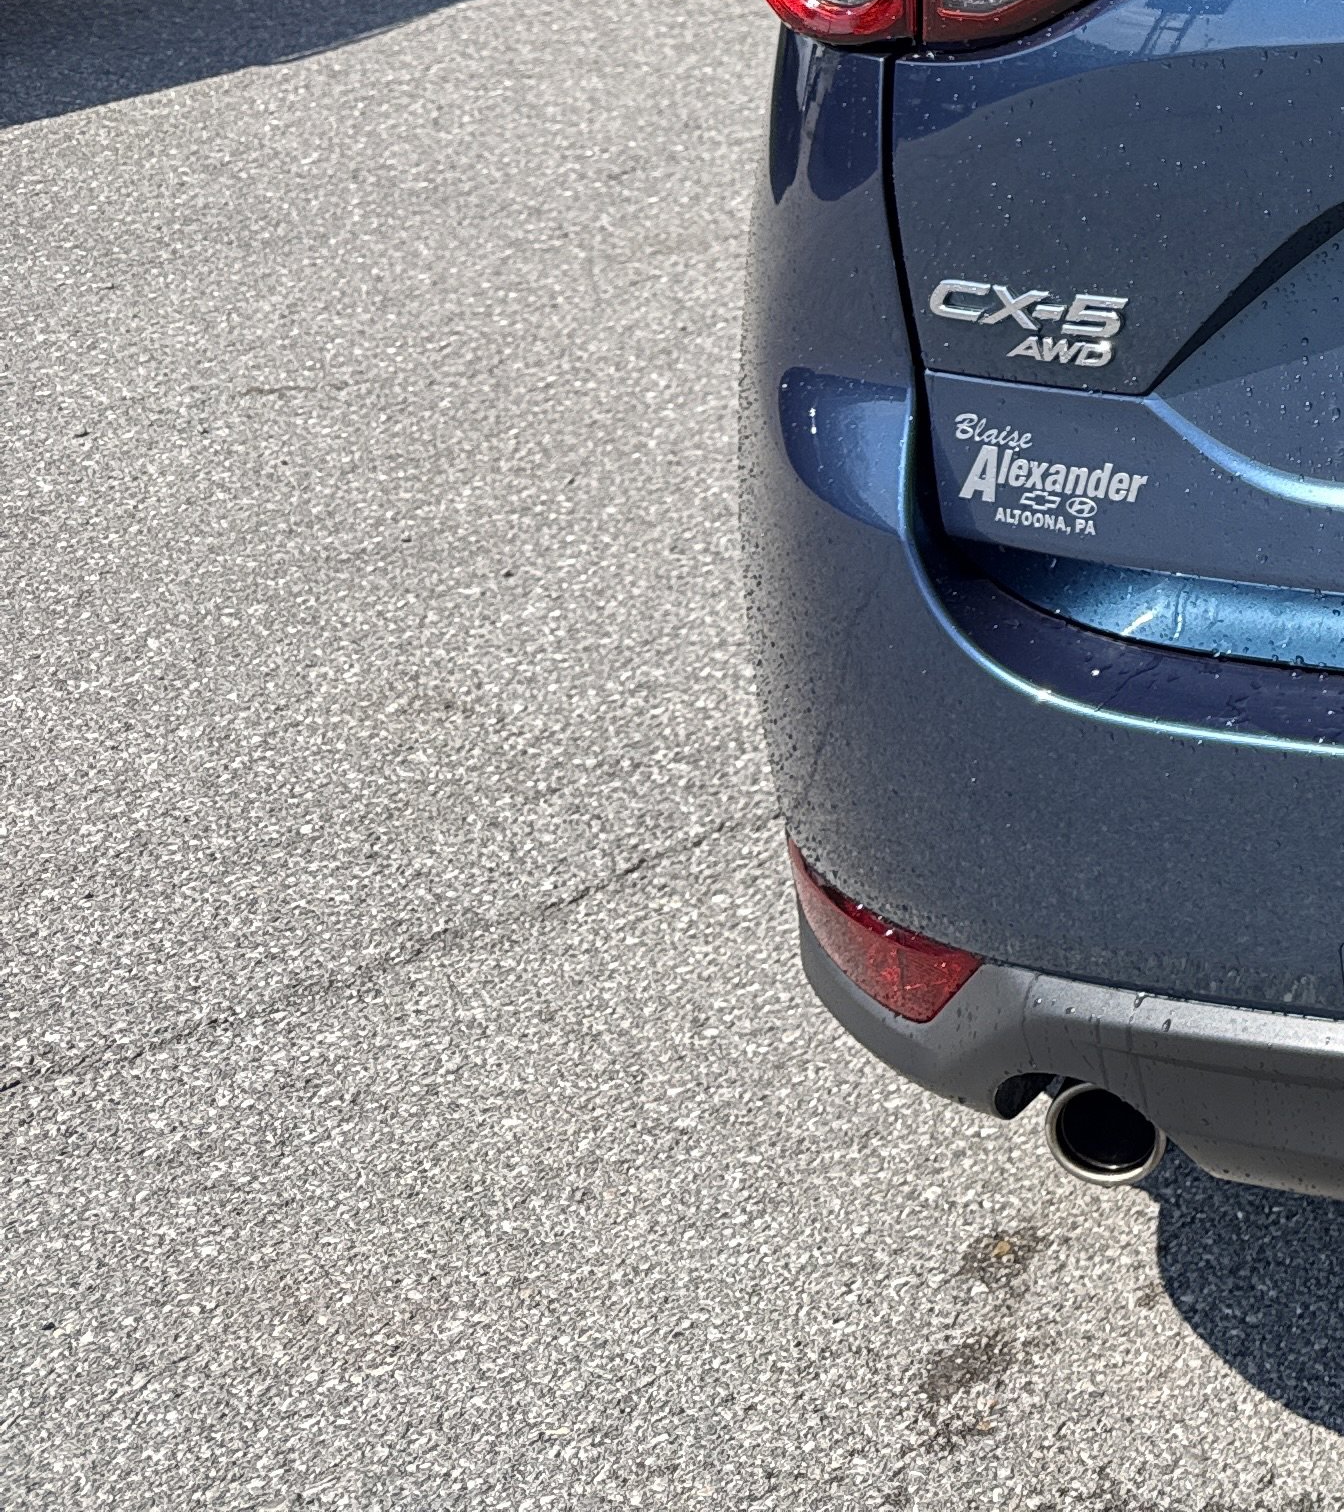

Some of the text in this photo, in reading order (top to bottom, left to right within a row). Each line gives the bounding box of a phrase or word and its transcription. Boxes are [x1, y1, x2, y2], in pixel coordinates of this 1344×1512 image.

[929, 279, 1129, 338] CX-5
[1006, 335, 1115, 367] AWD
[954, 412, 1034, 448] Blaise
[958, 444, 1149, 503] Alexander
[994, 507, 1096, 536] ALTOONA, PA
